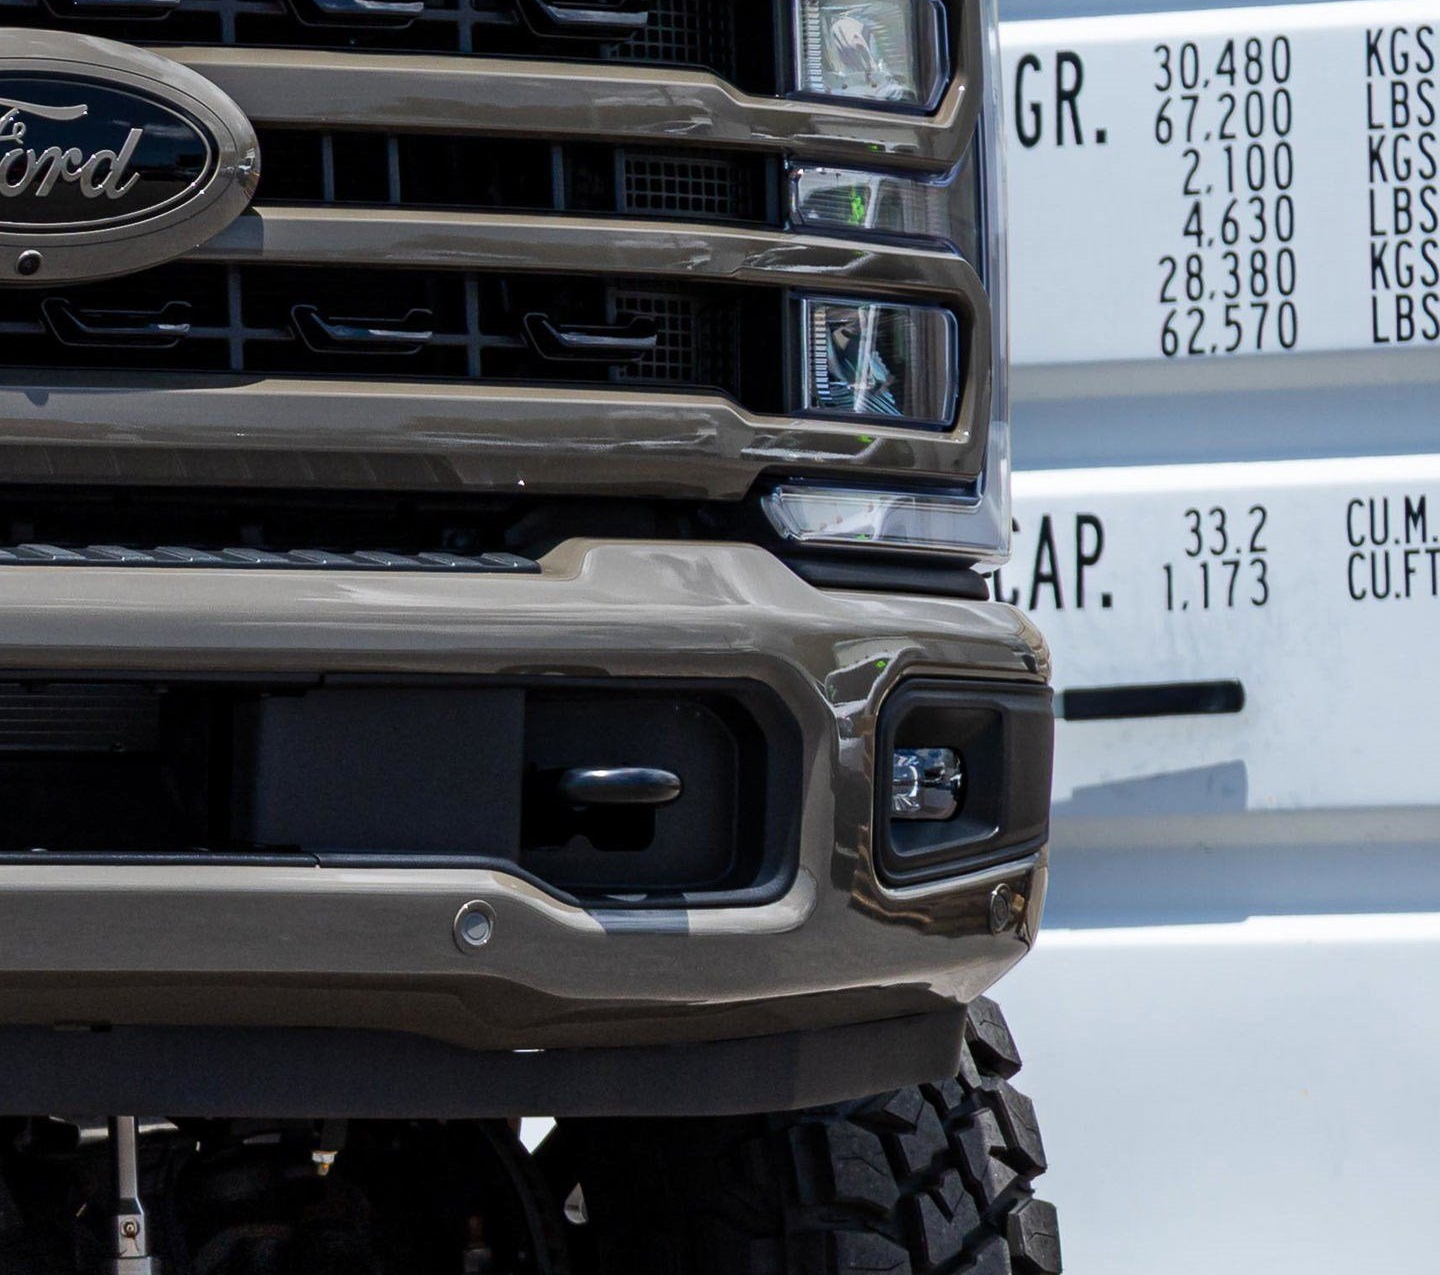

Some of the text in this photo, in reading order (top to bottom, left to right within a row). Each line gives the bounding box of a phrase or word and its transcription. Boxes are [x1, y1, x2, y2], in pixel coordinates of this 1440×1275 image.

[1014, 25, 1435, 149] GR. 30,480 KGS
[1155, 78, 1436, 145] 67,200 LBS
[1182, 131, 1437, 196] 2,100 KGS
[1183, 185, 1439, 248] 4,630 LBS
[1159, 238, 1440, 304] 28,380 KGS
[1160, 292, 1440, 359] 62,570 LBS
[1185, 505, 1267, 558] 33.2
[1163, 557, 1269, 611] 1,173
